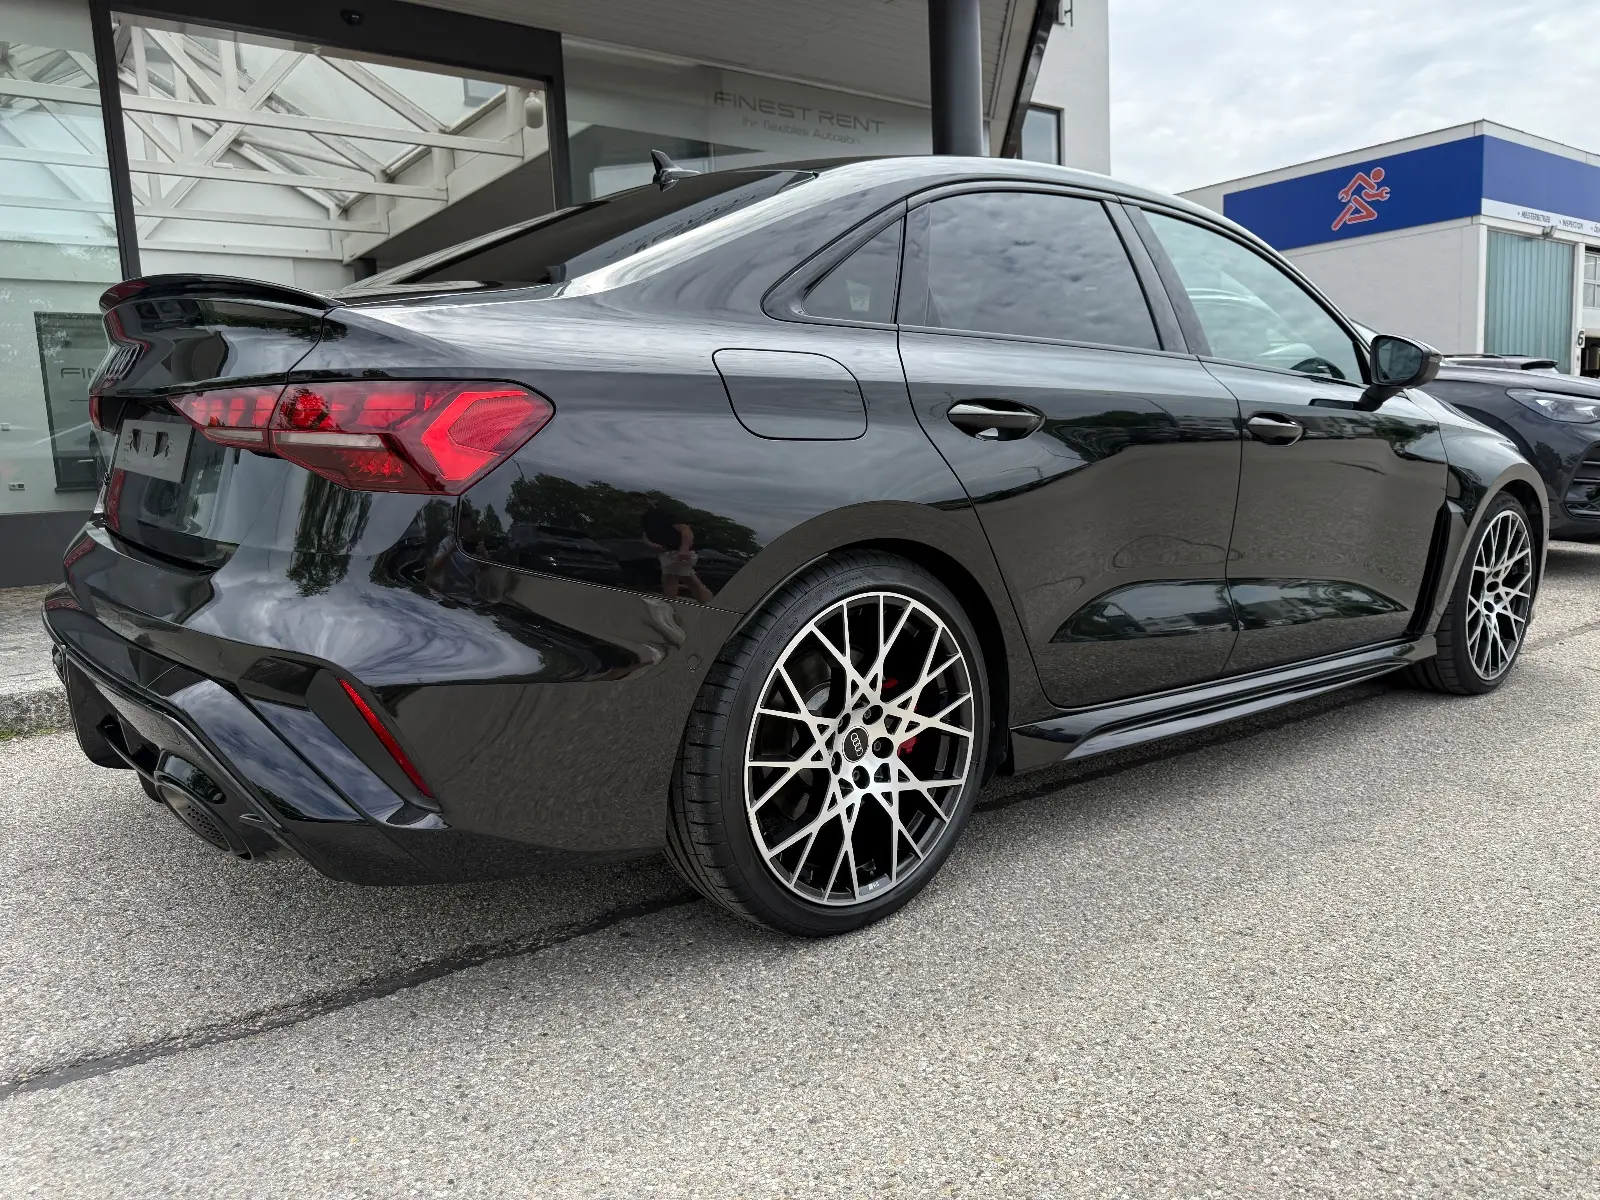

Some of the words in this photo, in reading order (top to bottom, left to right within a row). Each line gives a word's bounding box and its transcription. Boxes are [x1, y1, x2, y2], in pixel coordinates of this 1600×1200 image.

[713, 91, 812, 122] FINEST
[818, 111, 886, 134] RENT
[1577, 330, 1584, 346] 6
